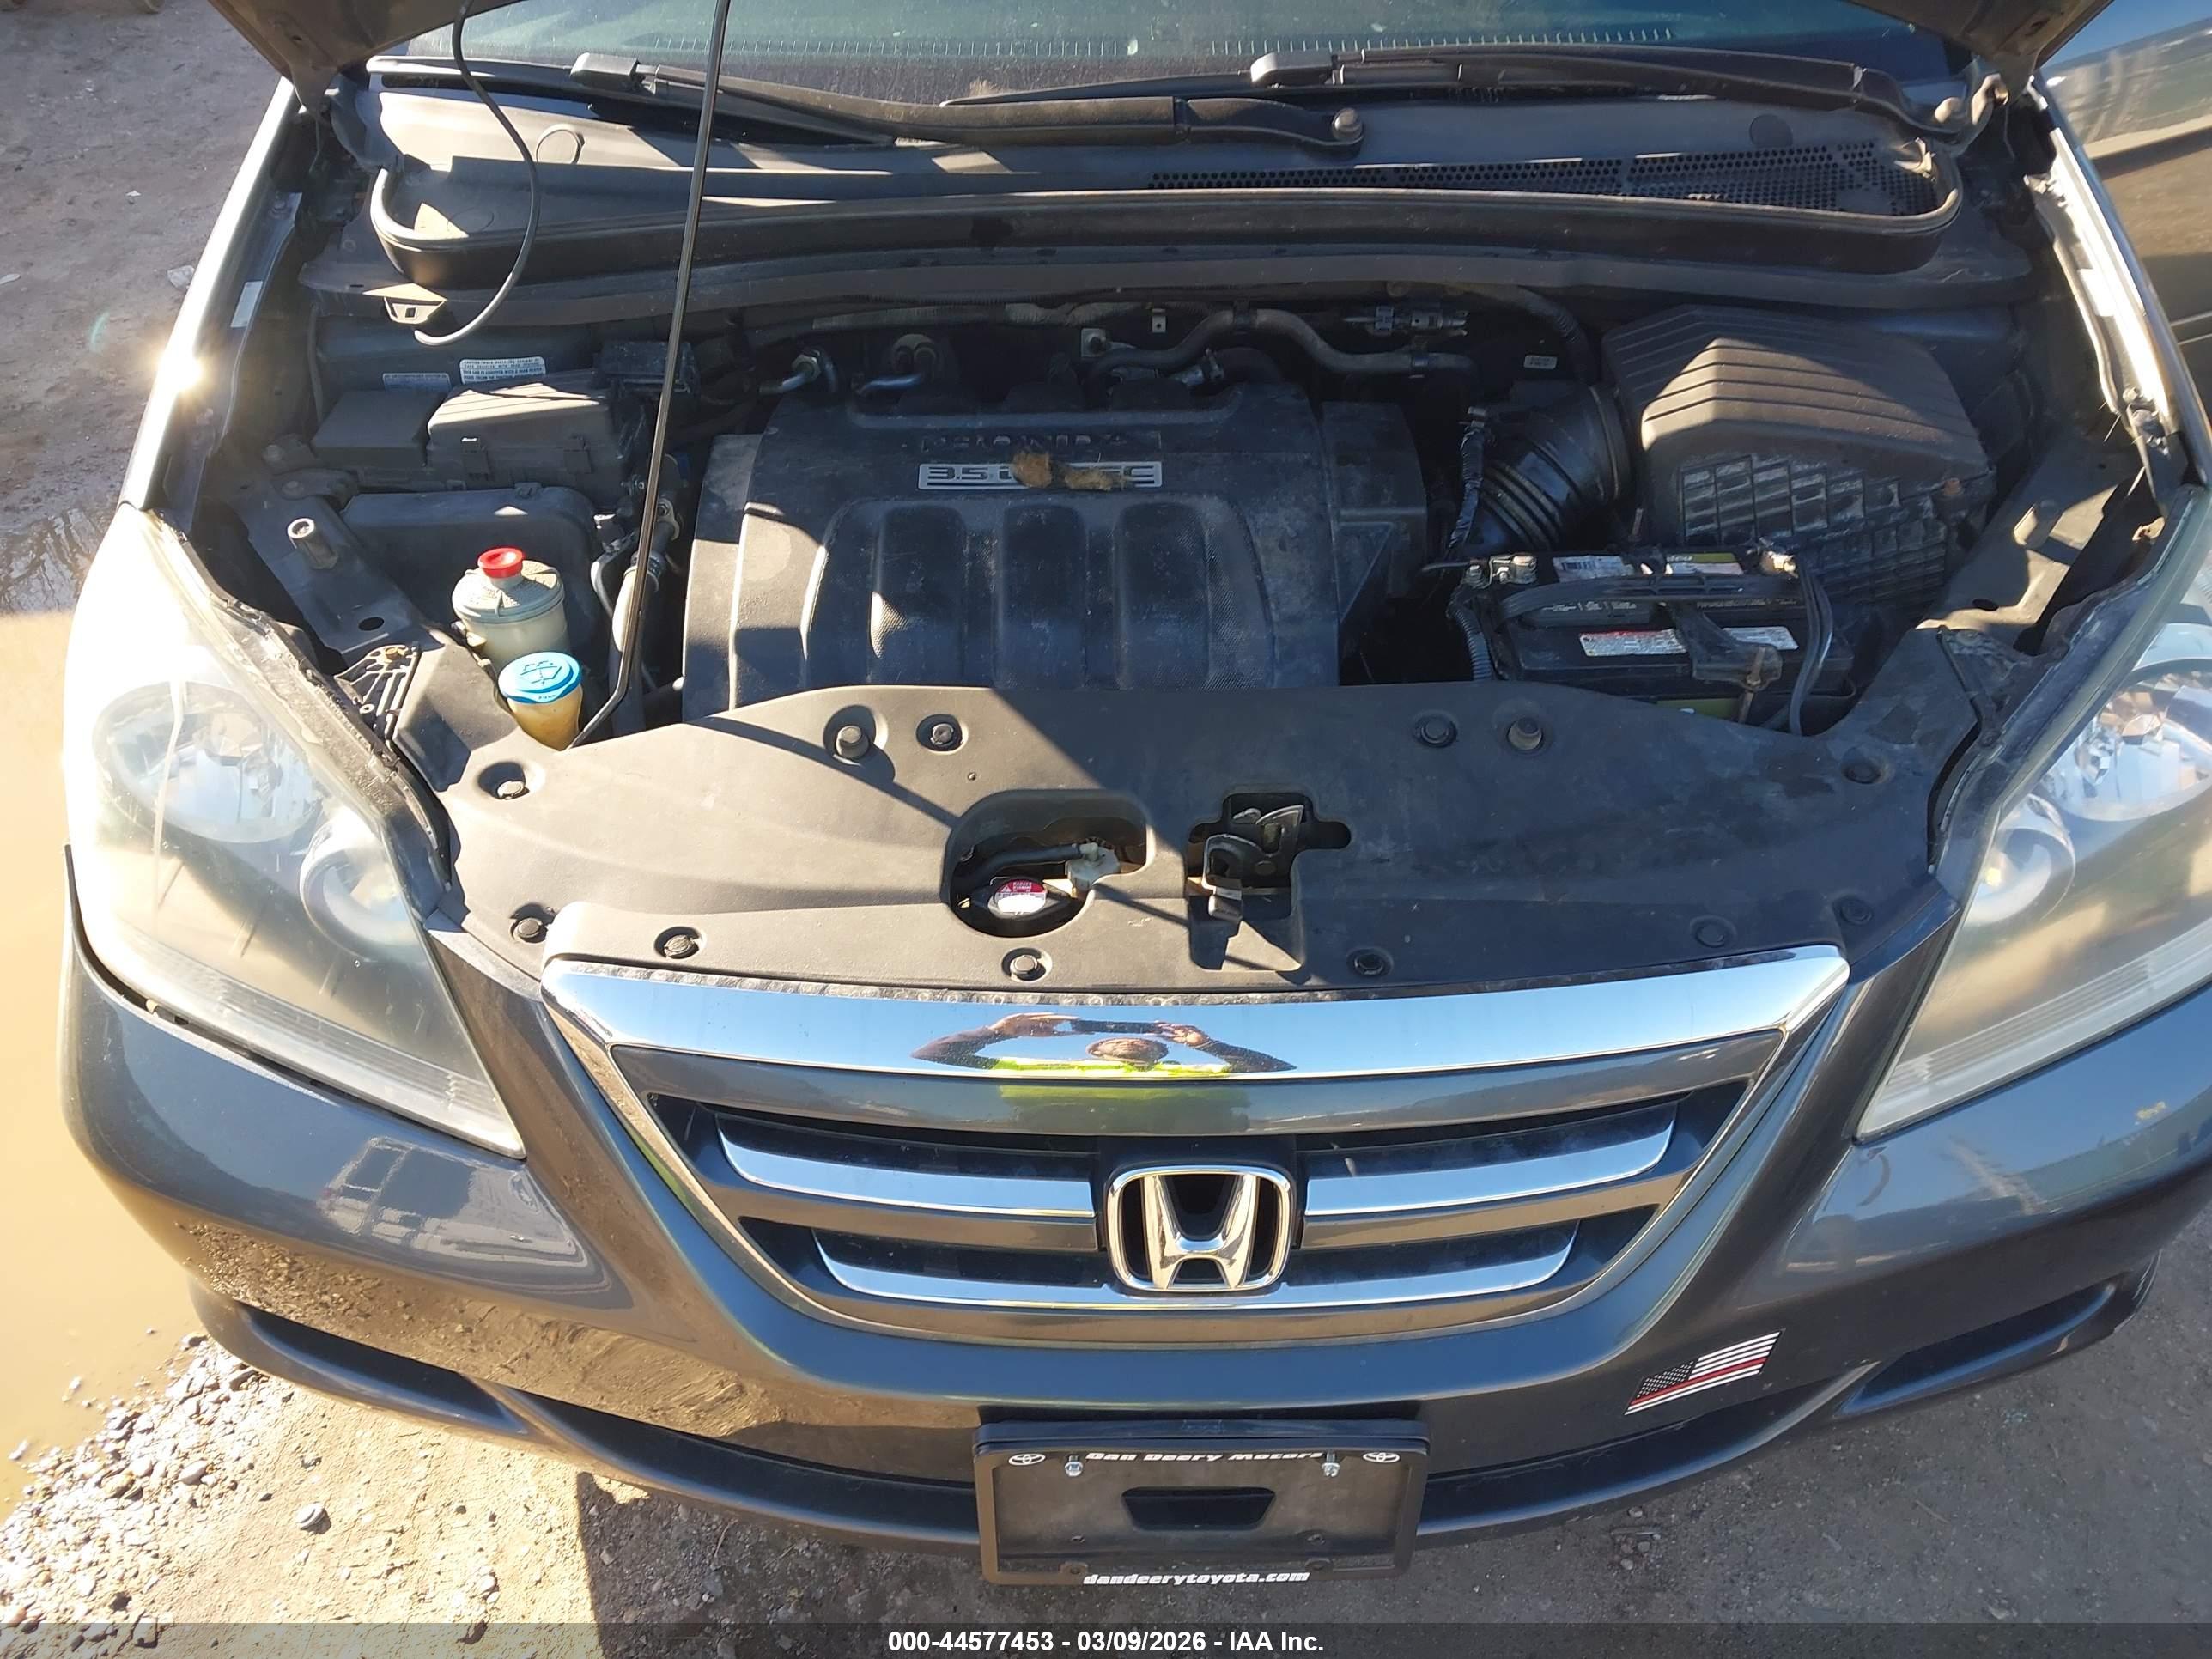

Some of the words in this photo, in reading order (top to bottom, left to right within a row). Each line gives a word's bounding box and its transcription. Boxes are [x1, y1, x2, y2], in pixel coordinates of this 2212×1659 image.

[927, 466, 989, 481] 3.5
[1085, 1452, 1138, 1461] Dan
[1143, 1453, 1224, 1462] Deery
[1228, 1452, 1323, 1461] Motors
[1082, 1572, 1310, 1586] dandeerytoyota.com
